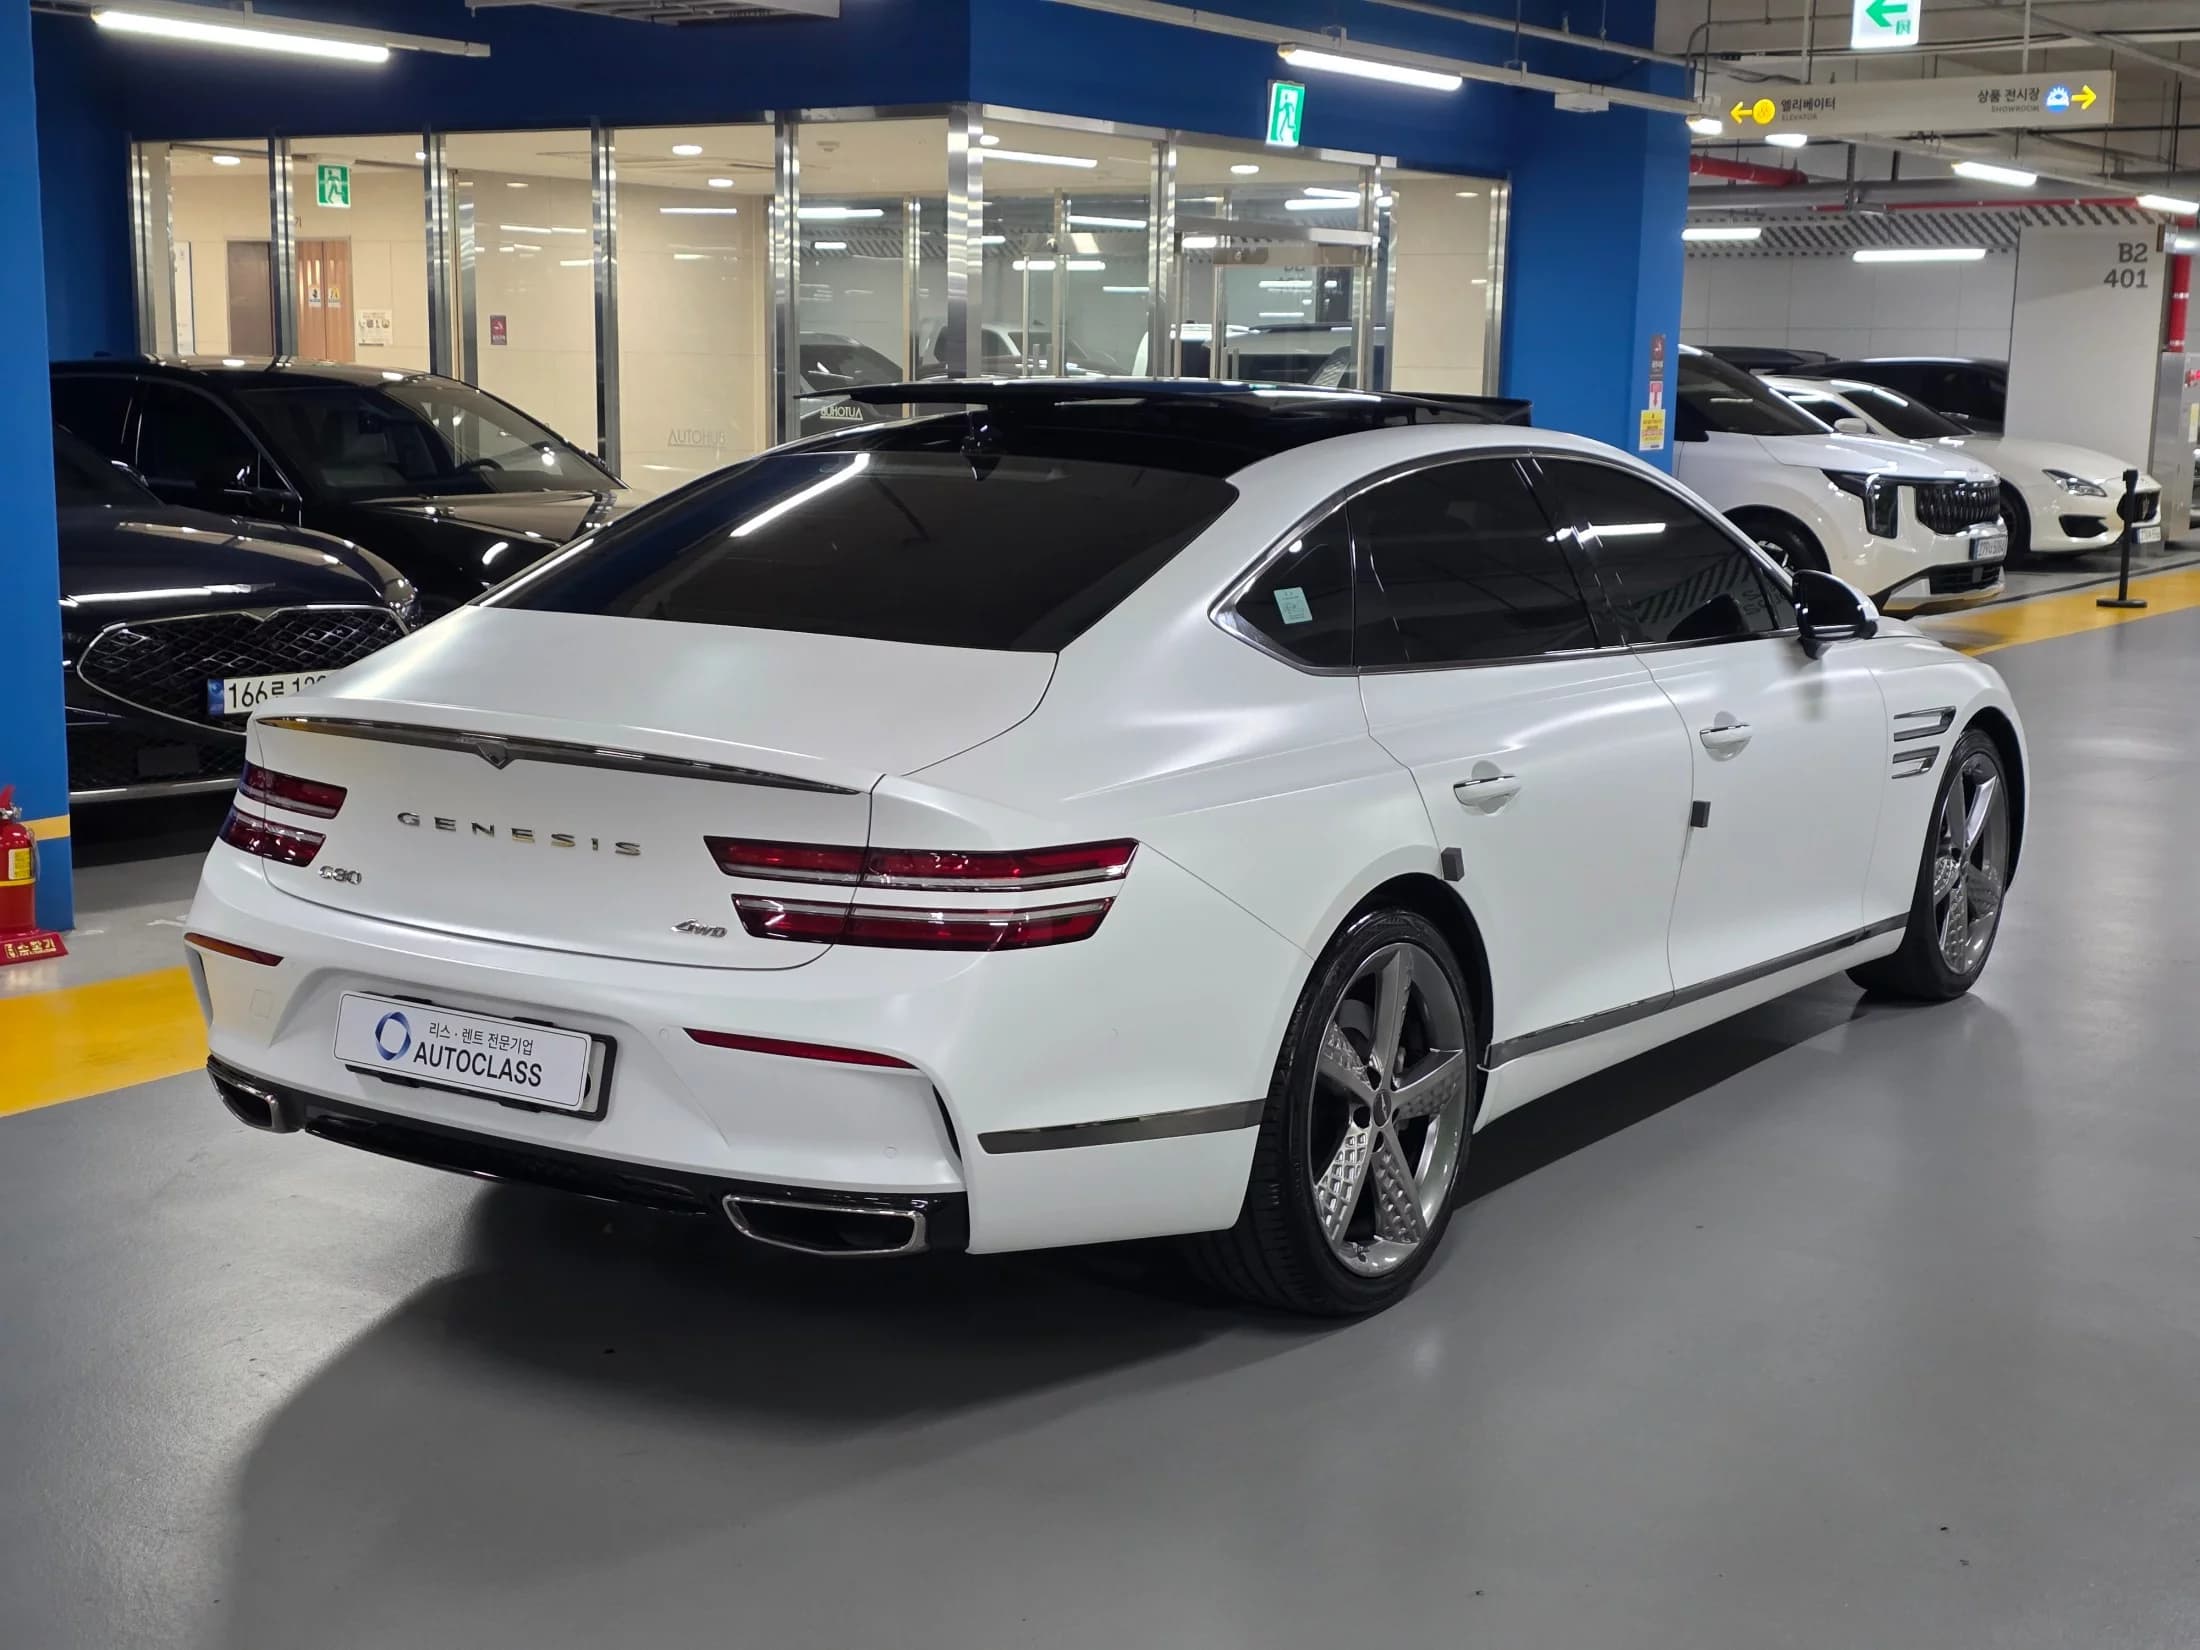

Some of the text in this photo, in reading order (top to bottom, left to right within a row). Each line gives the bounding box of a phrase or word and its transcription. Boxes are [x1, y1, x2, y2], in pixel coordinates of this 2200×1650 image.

[1780, 97, 1836, 112] 엘리베이터
[1977, 87, 2040, 103] 상품 전시장
[2118, 242, 2148, 263] B2
[2103, 268, 2148, 288] 401
[397, 812, 641, 856] GENESIS
[429, 1022, 451, 1039] 리스
[462, 1027, 484, 1045] 렌트
[487, 1032, 534, 1056] 전문기업
[413, 1041, 543, 1087] AUTOCLASS
